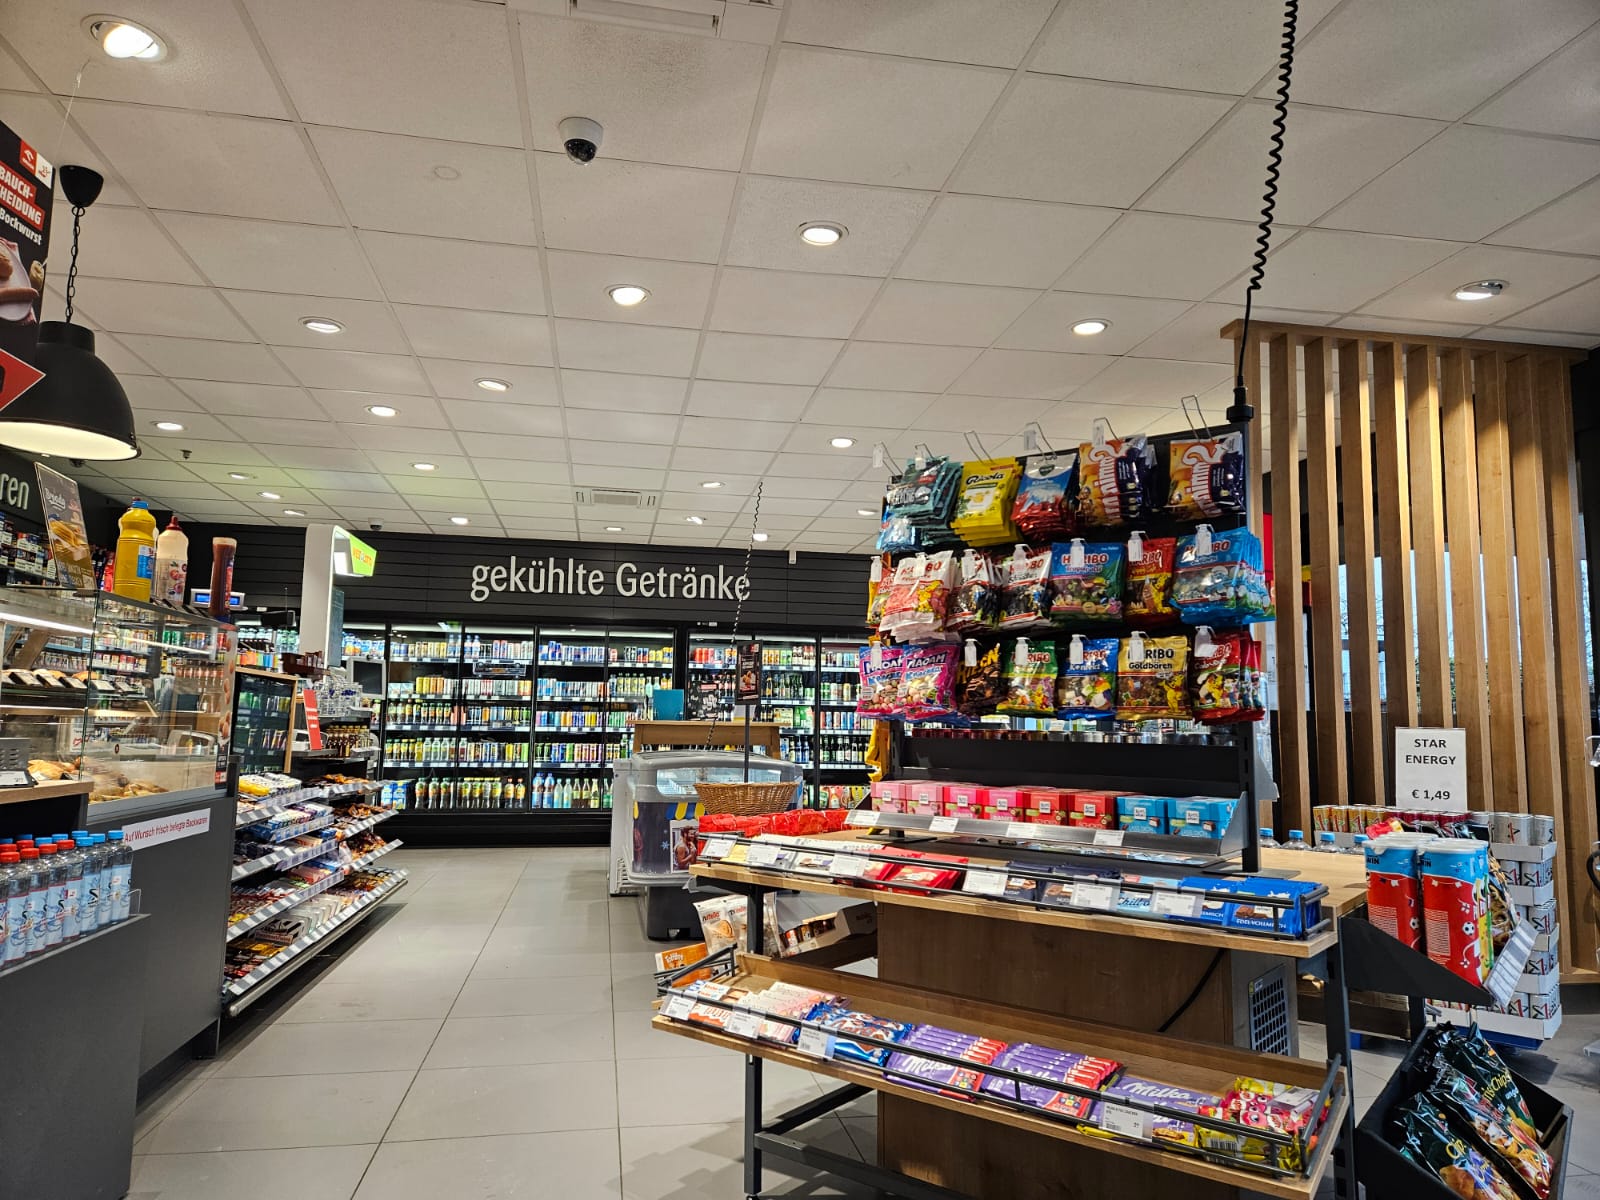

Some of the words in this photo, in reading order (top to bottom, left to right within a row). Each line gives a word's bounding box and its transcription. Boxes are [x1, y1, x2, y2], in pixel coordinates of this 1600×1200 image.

[0, 207, 42, 246] Bockwurst
[966, 472, 1005, 486] Ricola
[470, 556, 604, 602] gekühlte
[616, 562, 750, 601] Getränke
[1414, 738, 1447, 749] STAR
[1405, 754, 1457, 766] ENERGY
[1411, 789, 1420, 800] €
[1423, 789, 1451, 802] 1,49
[1122, 1082, 1192, 1100] Milka
